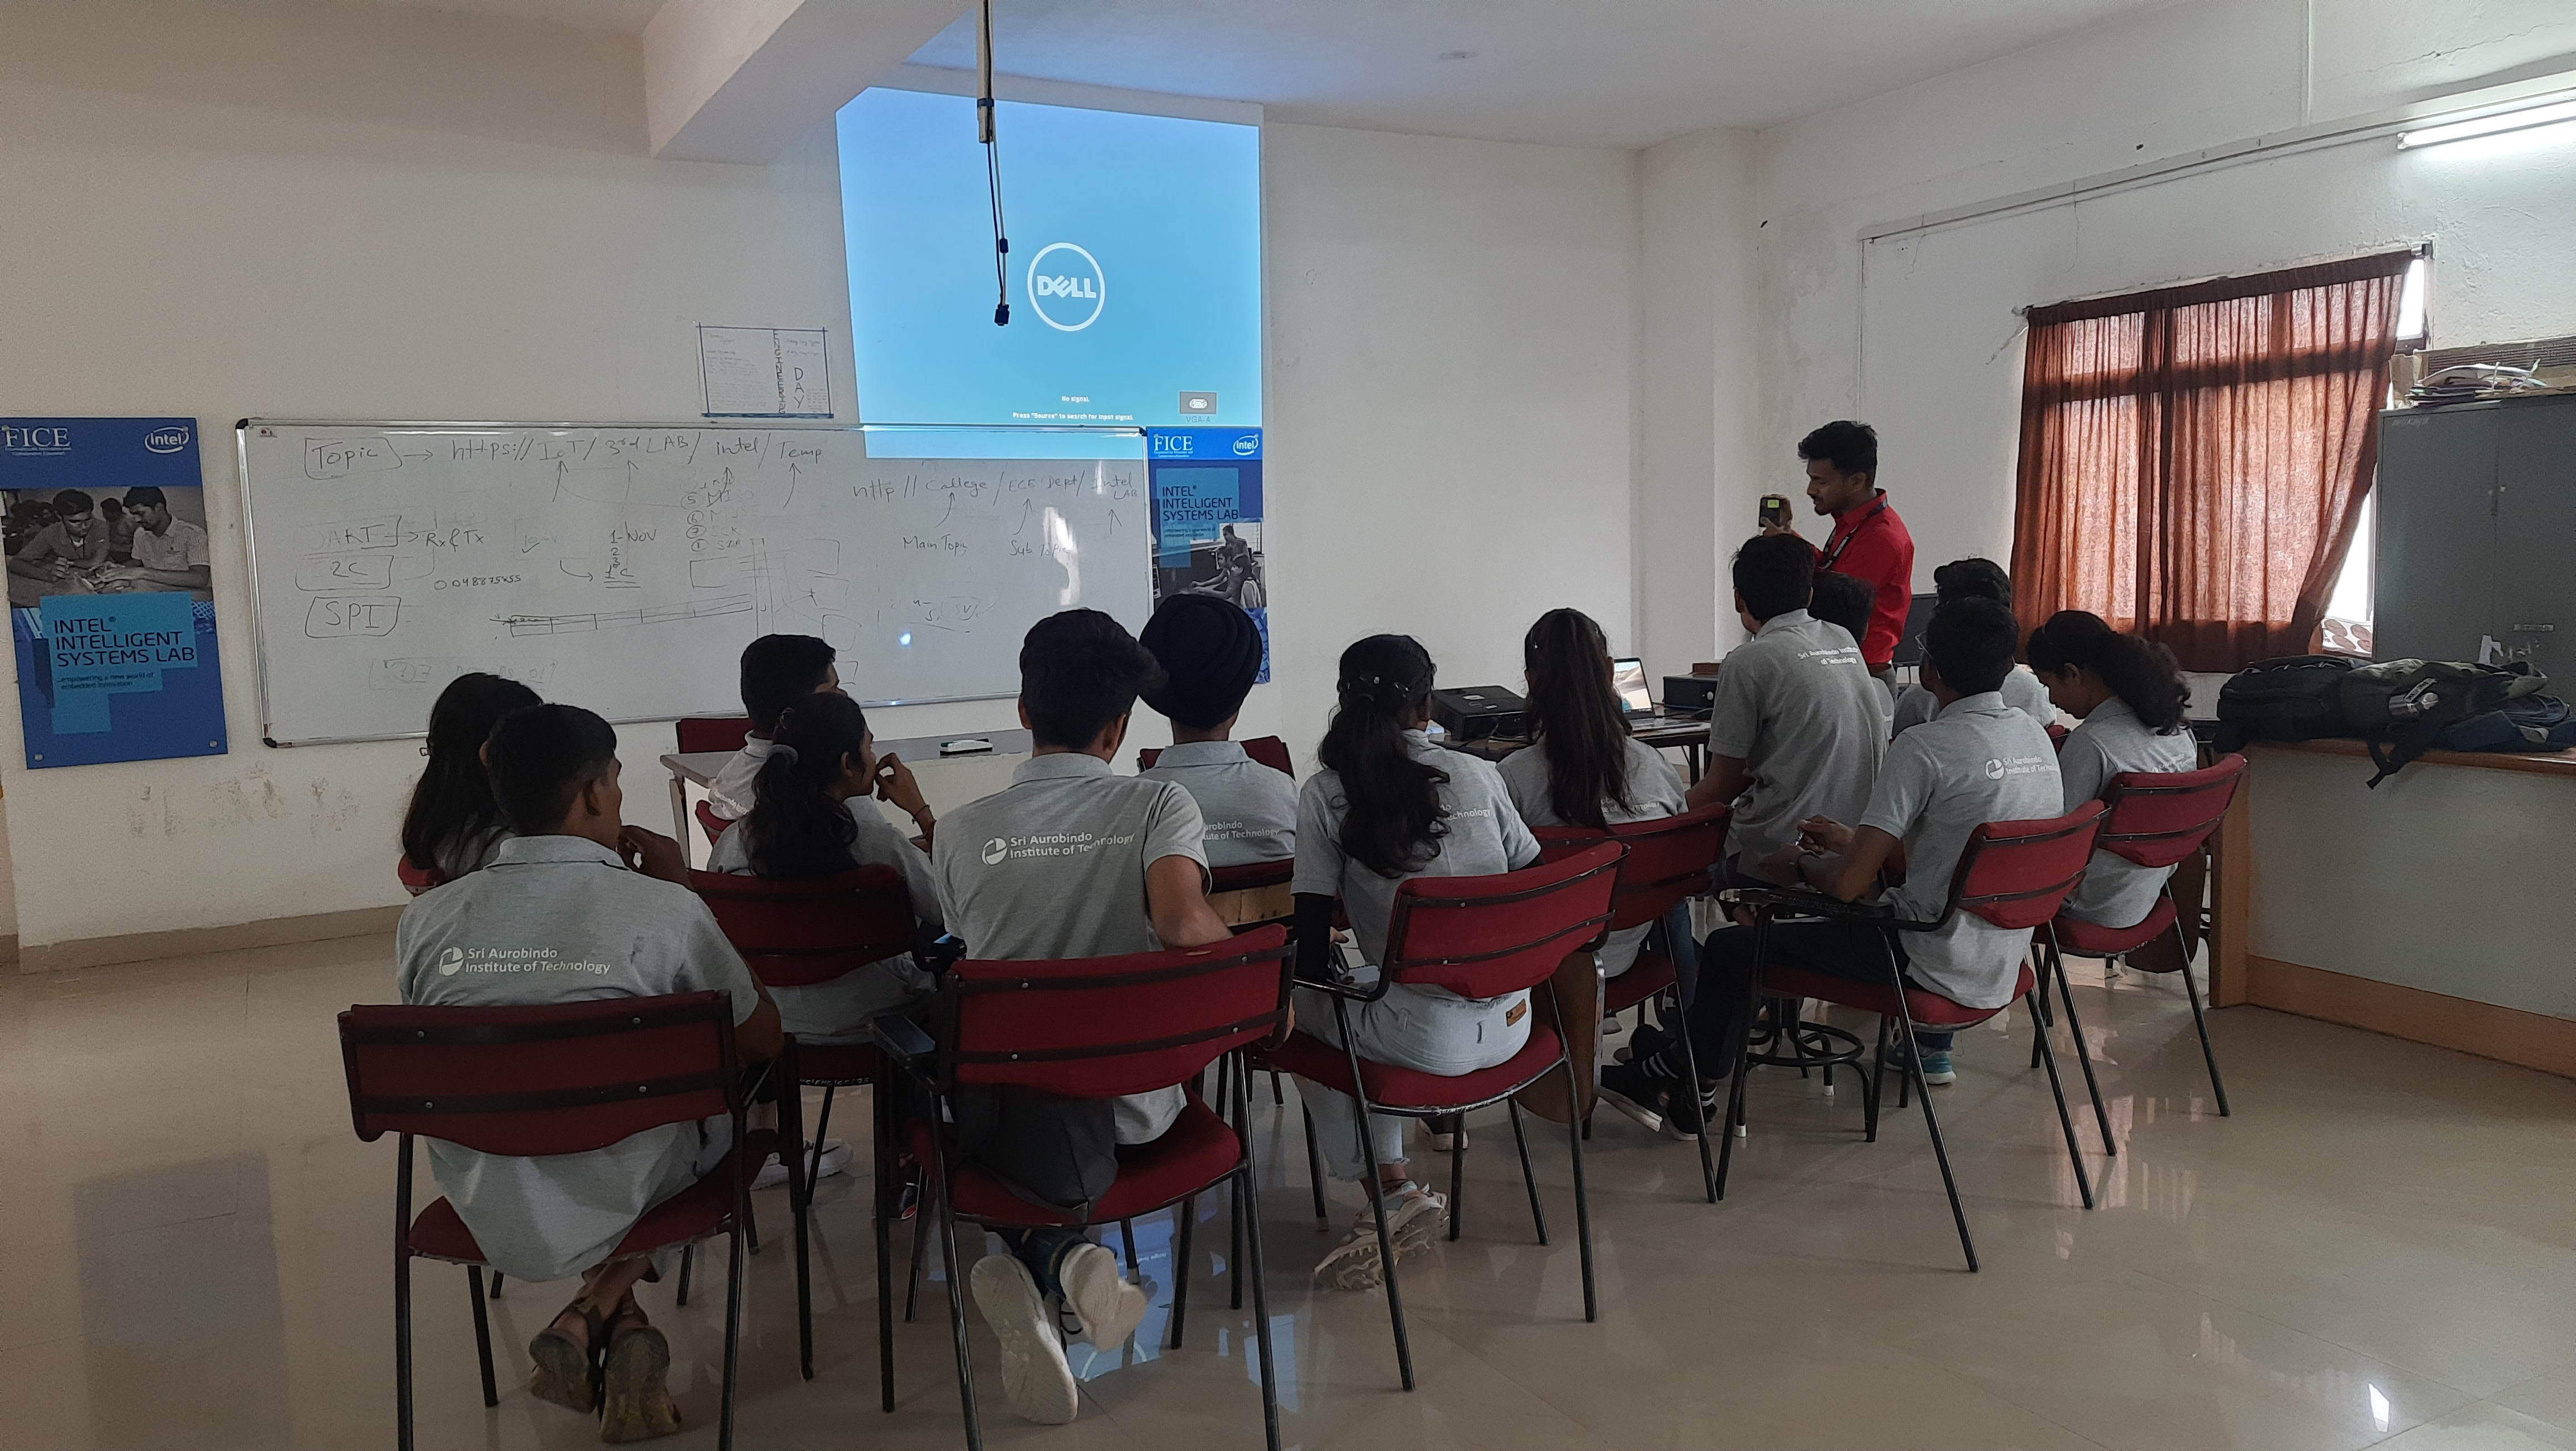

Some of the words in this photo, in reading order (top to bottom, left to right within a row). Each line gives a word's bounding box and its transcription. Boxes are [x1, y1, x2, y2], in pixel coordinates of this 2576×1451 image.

[1036, 274, 1097, 298] DELL
[794, 367, 804, 409] DAY
[1071, 395, 1090, 403] signal.
[6, 427, 71, 447] FICE
[1154, 435, 1193, 451] FICE
[312, 441, 379, 469] Topic
[1009, 479, 1036, 491] ECE
[1163, 497, 1233, 509] INTELLIGENT
[1163, 510, 1214, 521] SYSTEMS
[1217, 509, 1238, 520] LAB
[902, 535, 938, 549] Main
[1009, 539, 1033, 556] Sub
[611, 547, 621, 556] 2
[325, 601, 385, 631] SPI
[55, 631, 183, 650] INTELLIGENT
[57, 649, 149, 667] SYSTEMS
[155, 647, 194, 662] LAB
[1010, 836, 1027, 846] Sri
[1030, 831, 1092, 845] Aurobindo
[1220, 831, 1230, 839] of
[1231, 828, 1280, 839] Technology
[1009, 846, 1060, 859] Institute
[1062, 844, 1076, 856] of
[467, 948, 485, 960] Sri
[489, 947, 558, 960] Aurobindo
[465, 961, 521, 973] Institute
[523, 961, 538, 972] of
[540, 960, 611, 975] Technology
